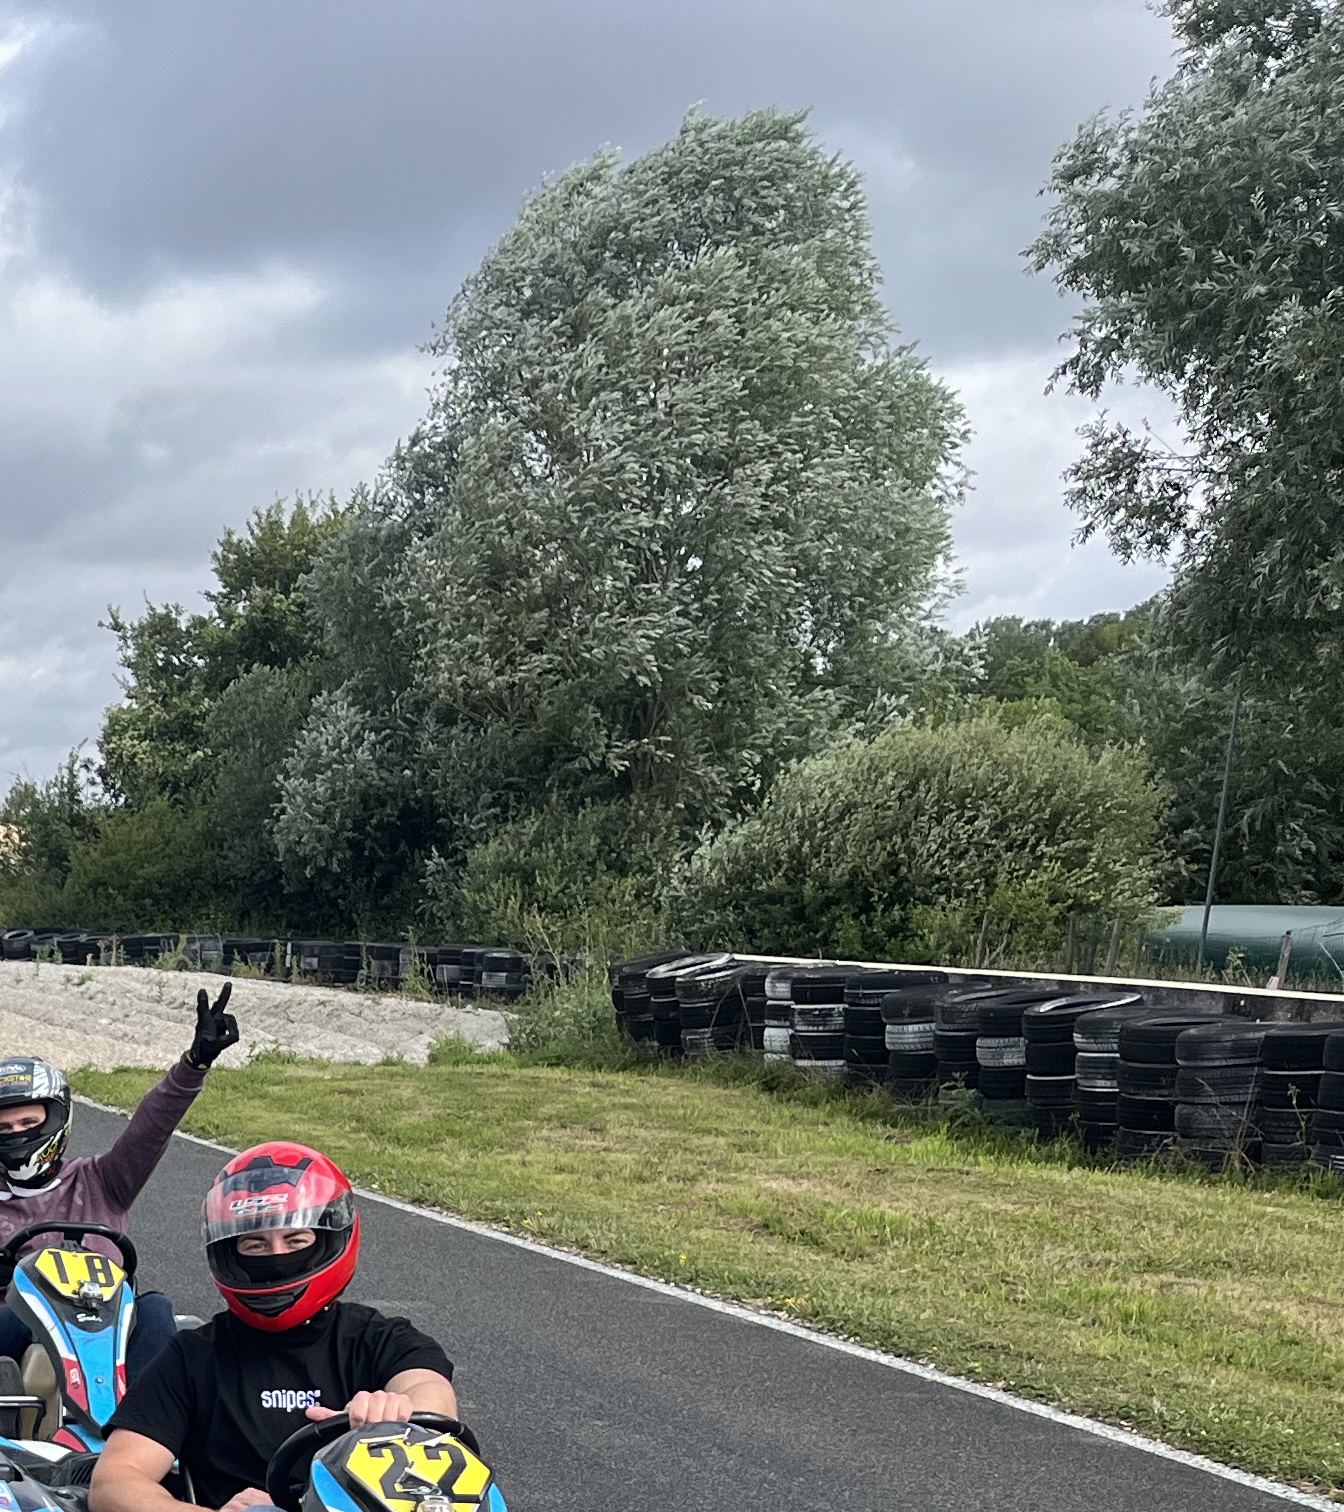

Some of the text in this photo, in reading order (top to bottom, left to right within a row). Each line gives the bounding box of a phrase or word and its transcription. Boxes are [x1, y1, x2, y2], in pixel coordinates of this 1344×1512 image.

[47, 1250, 115, 1288] 18
[260, 1389, 315, 1413] snipes
[367, 1442, 481, 1504] 22
